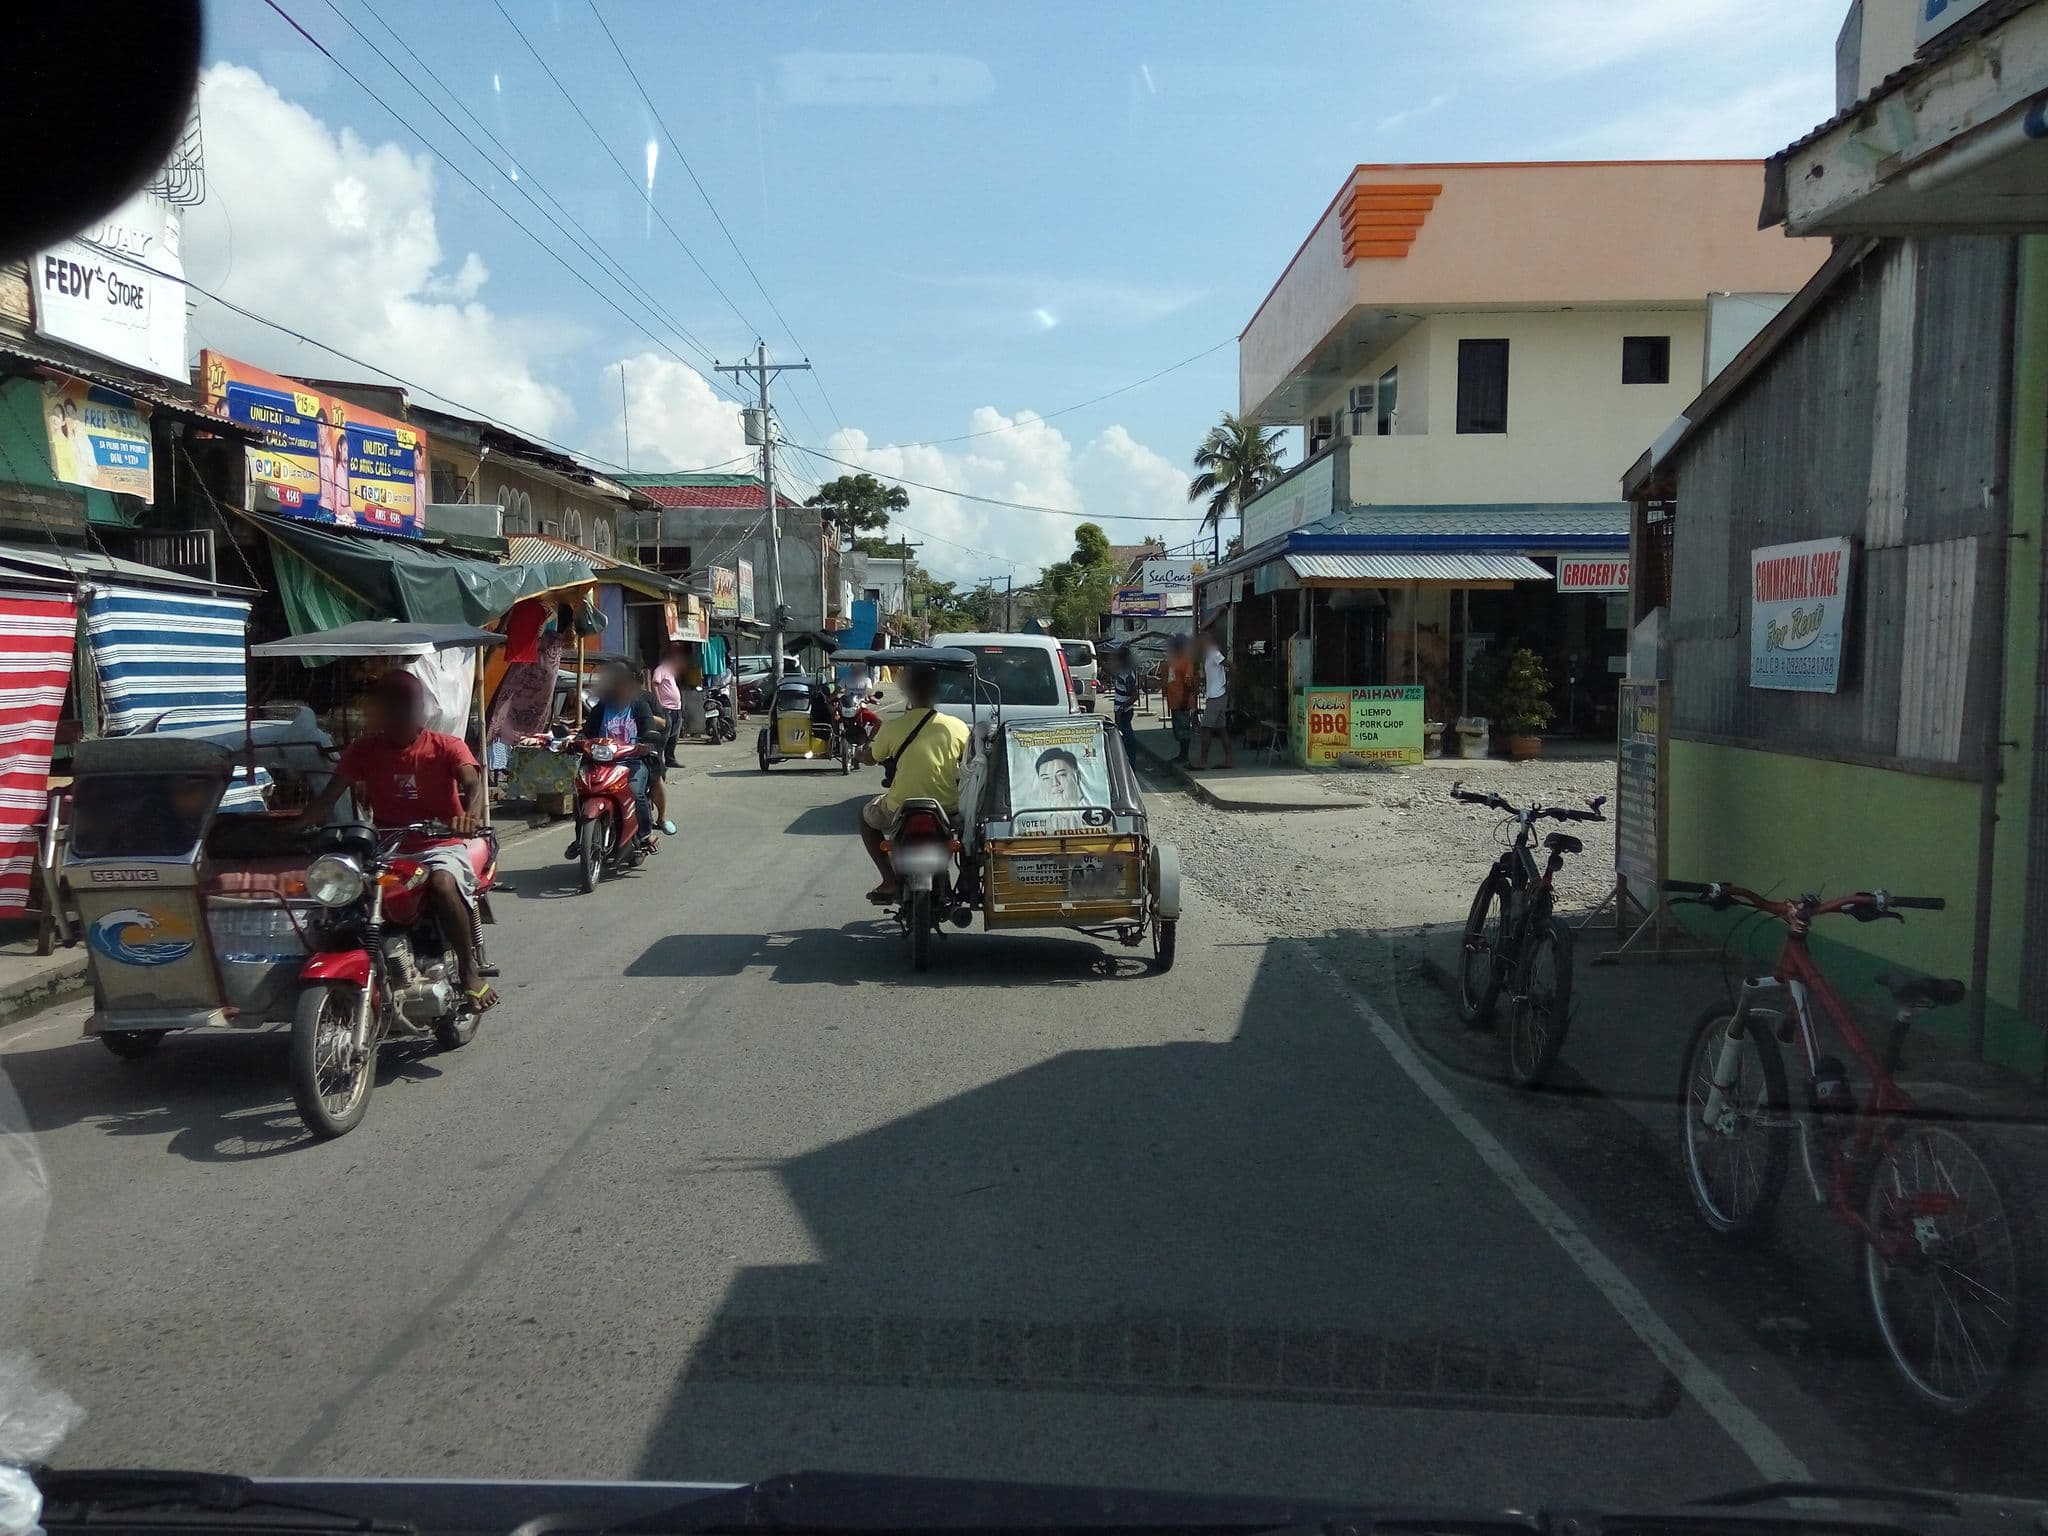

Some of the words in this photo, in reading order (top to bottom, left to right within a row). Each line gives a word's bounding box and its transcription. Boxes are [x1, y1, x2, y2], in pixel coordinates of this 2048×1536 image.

[107, 271, 145, 310] STORE
[1149, 569, 1197, 584] SeaCoas
[1563, 563, 1618, 586] GROCERY
[1756, 554, 1809, 602] COMMERCIAL
[1810, 550, 1842, 597] SPACE
[1766, 618, 1789, 652] For
[1791, 602, 1825, 641] Rent
[1352, 688, 1404, 700] PAIHAW
[1361, 708, 1392, 717] LIEMPO
[1310, 713, 1349, 735] BBQ
[1360, 720, 1383, 729] PORK
[1384, 720, 1405, 729] CHOP
[1360, 732, 1379, 741] ISDA
[1380, 750, 1403, 759] HERE
[1091, 809, 1104, 826] 5
[1021, 820, 1039, 828] VOTE
[1054, 827, 1108, 836] CHRISTIAN
[93, 870, 159, 881] SERVICE
